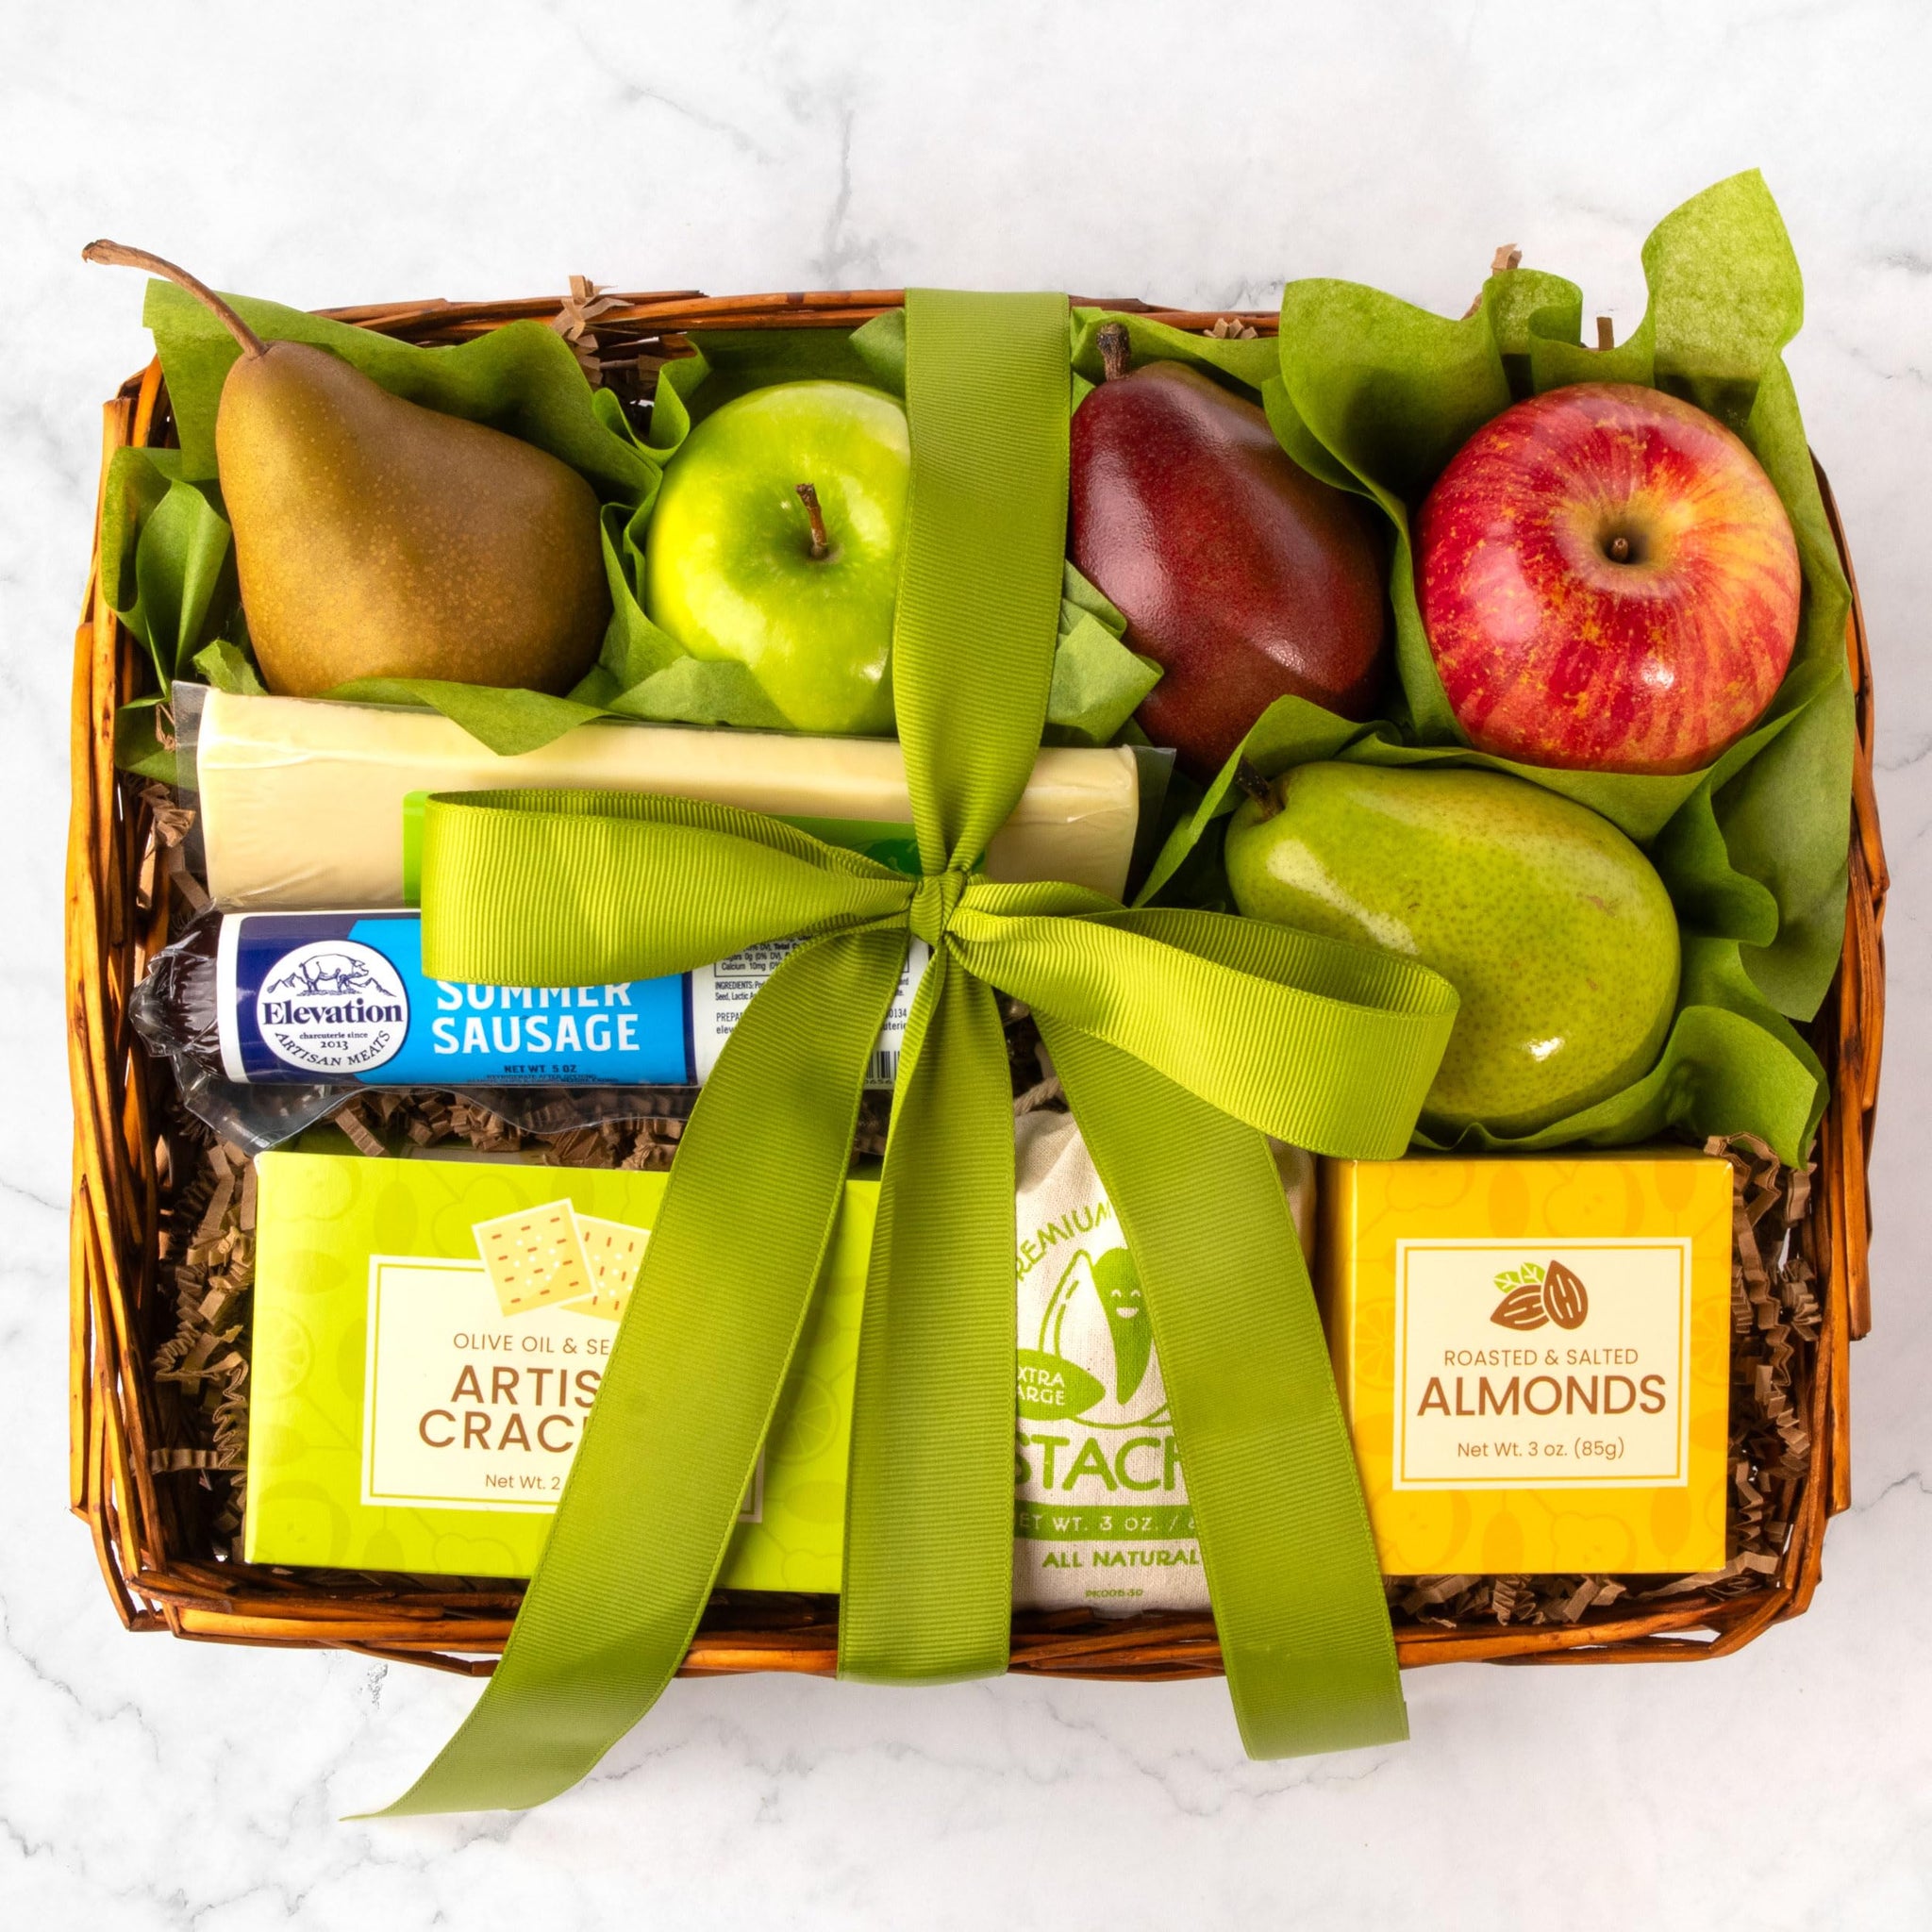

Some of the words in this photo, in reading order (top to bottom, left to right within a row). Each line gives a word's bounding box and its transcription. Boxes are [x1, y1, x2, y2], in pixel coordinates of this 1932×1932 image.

[721, 962, 745, 971] Calcium
[750, 962, 766, 972] 10mg
[715, 981, 754, 990] INGREDIENTS:
[715, 992, 729, 1001] Seed,
[731, 991, 748, 1000] Lactic
[262, 997, 404, 1025] Elevation
[299, 1031, 345, 1040] charcuterie
[432, 1014, 641, 1055] SAUSAGE
[275, 1032, 341, 1067] ARTISAN
[348, 1030, 391, 1066] MEATS
[320, 1041, 349, 1051] 2013
[504, 1064, 525, 1074] NET
[527, 1064, 545, 1074] WT
[552, 1064, 559, 1073] 5
[562, 1064, 577, 1073] OZ
[454, 1333, 513, 1351] OLIVE
[522, 1336, 555, 1353] OIL
[562, 1338, 577, 1354] &
[587, 1339, 610, 1356] SE
[1444, 1349, 1538, 1368] ROASTED
[1544, 1349, 1559, 1365] &
[1566, 1348, 1639, 1365] SALTED
[450, 1364, 602, 1408] ARTIS
[1417, 1374, 1666, 1416] ALMONDS
[419, 1408, 589, 1453] CRAC
[1457, 1441, 1489, 1457] Net
[1494, 1441, 1523, 1457] Wt.
[1527, 1441, 1539, 1457] 3
[1544, 1443, 1568, 1457] oz.
[1574, 1436, 1624, 1460] (85g)
[485, 1474, 514, 1488] Net
[520, 1474, 546, 1490] Wt.
[551, 1476, 560, 1490] 2
[1052, 1516, 1089, 1532] WT.
[1099, 1515, 1113, 1532] 3
[1124, 1517, 1158, 1533] OZ.
[1042, 1551, 1082, 1569] ALL
[1092, 1548, 1200, 1568] NATURAL
